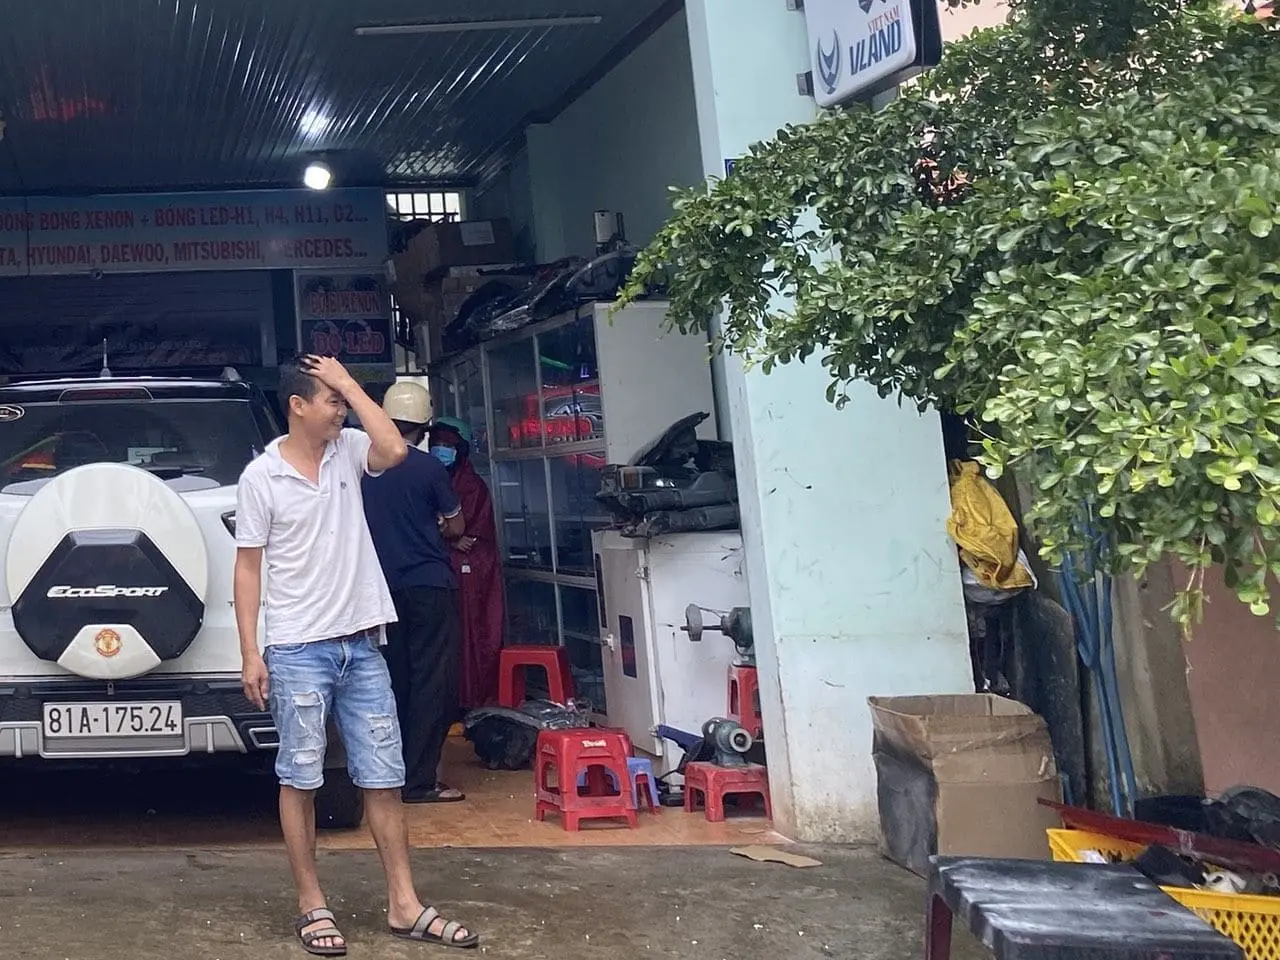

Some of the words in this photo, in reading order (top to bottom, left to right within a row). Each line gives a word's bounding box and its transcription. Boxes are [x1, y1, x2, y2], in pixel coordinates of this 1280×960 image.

[849, 19, 902, 76] VLAND
[85, 208, 134, 230] XENON
[273, 237, 368, 259] ERCEDES...
[49, 704, 177, 734] 81A-175.24
